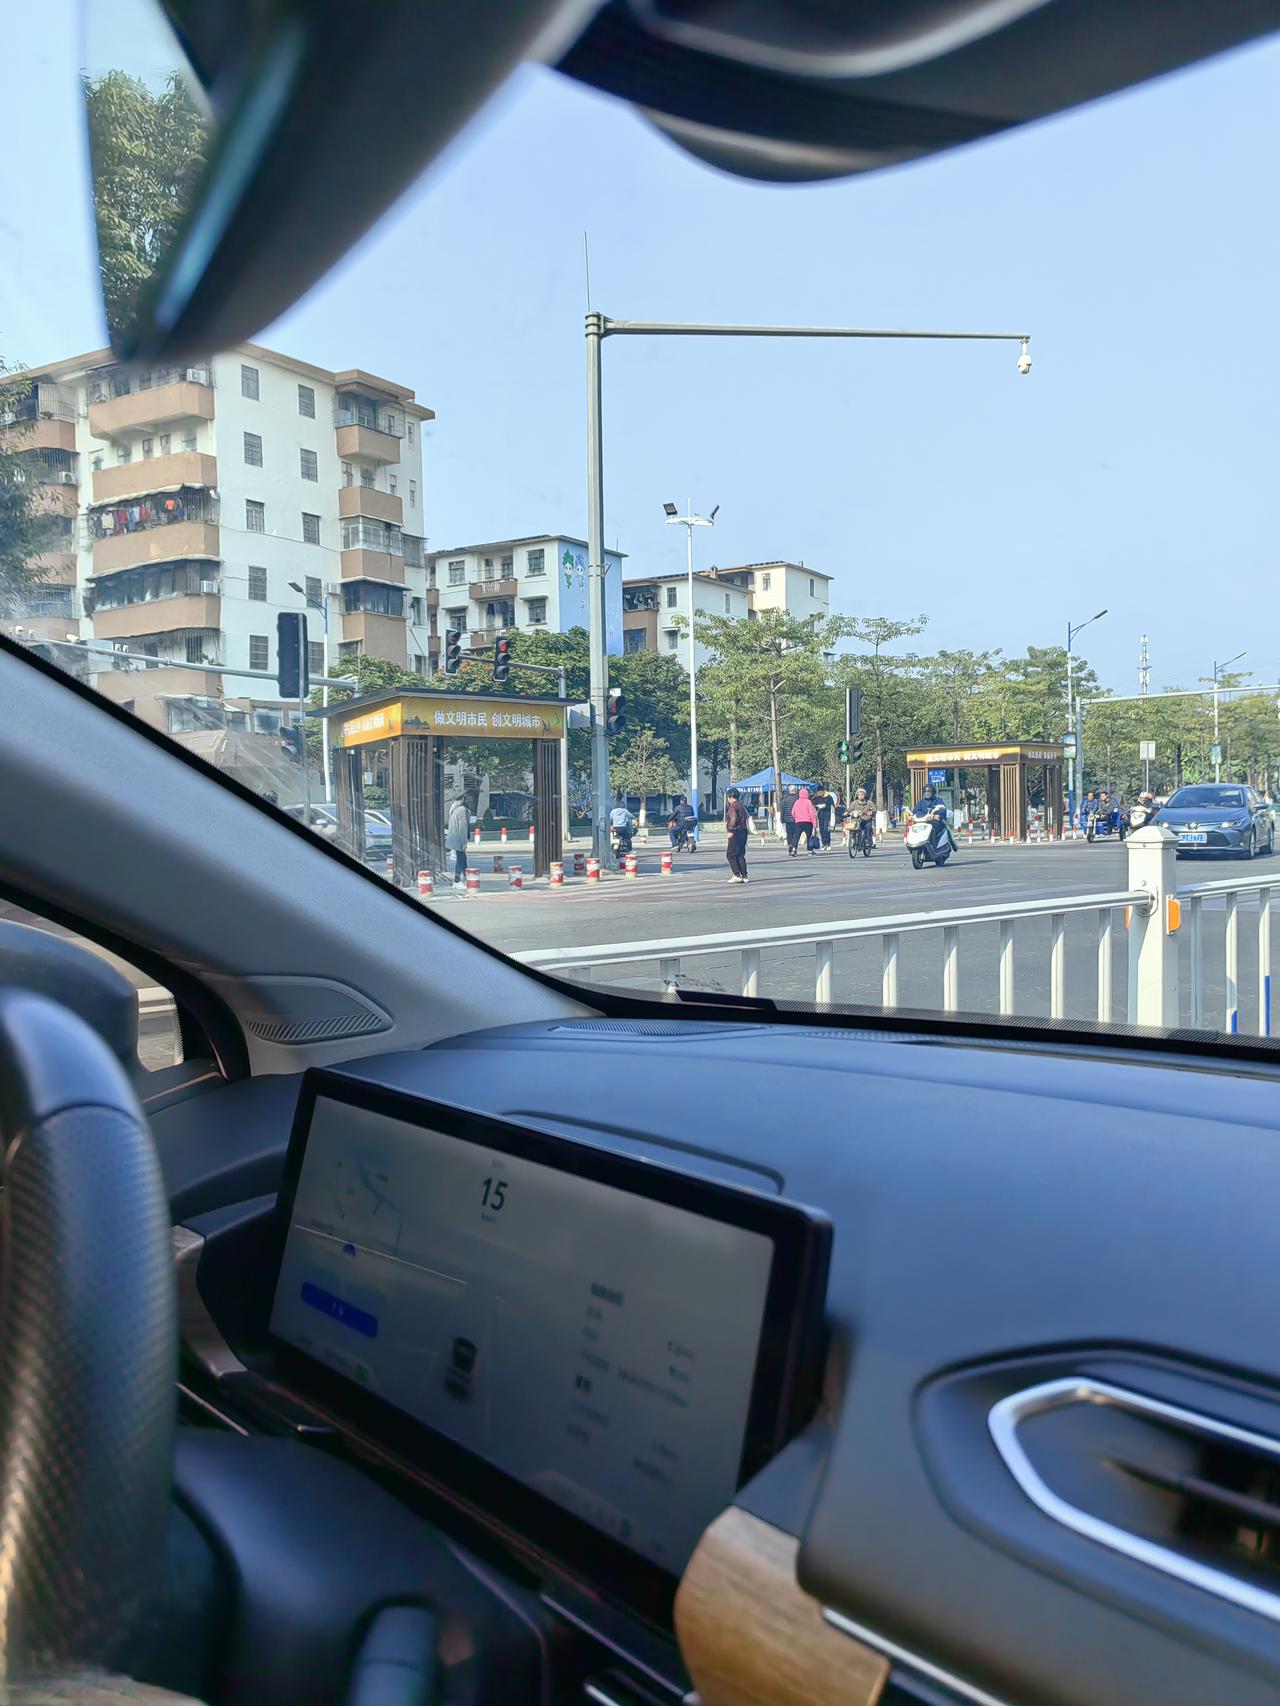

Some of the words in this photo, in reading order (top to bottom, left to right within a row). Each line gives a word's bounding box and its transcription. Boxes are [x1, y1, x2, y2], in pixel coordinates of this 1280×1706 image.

[434, 710, 488, 727] 做文明市民
[492, 712, 542, 728] 创文明城市
[482, 1177, 508, 1211] 15
